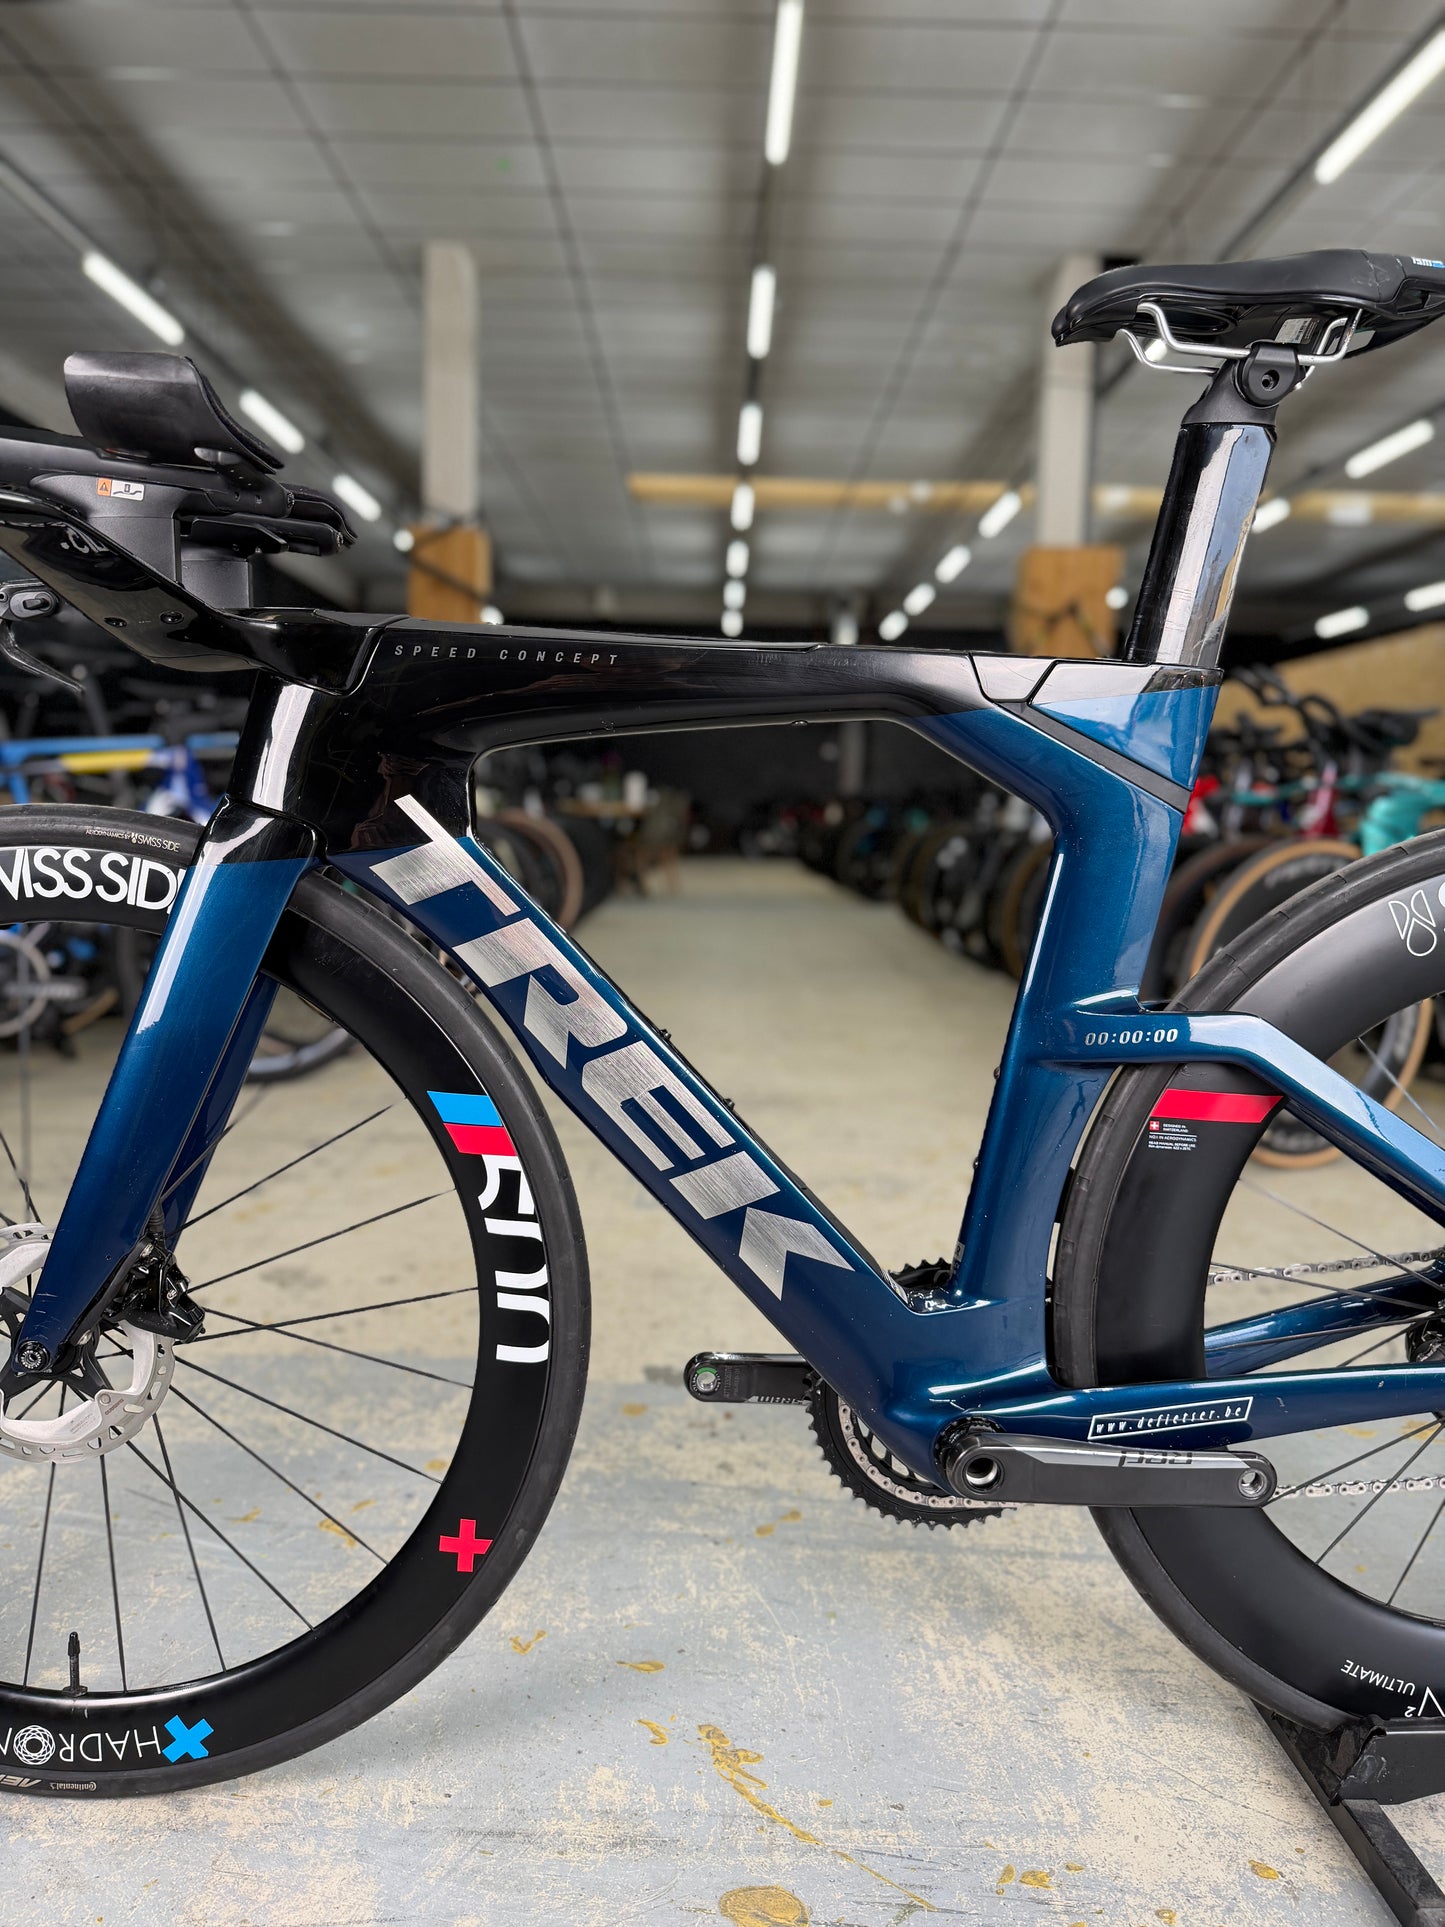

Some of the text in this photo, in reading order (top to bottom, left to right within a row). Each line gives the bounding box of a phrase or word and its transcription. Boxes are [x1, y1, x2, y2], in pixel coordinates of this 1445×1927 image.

[394, 645, 618, 664] SPEED CONCEPT
[138, 834, 162, 848] SWISS
[162, 840, 181, 852] SIDE
[95, 852, 187, 914] SID
[369, 794, 856, 1301] TREK
[1085, 1028, 1178, 1046] 00:00:00
[1096, 1405, 1242, 1433] www.defietser.be
[1340, 1659, 1416, 1696] ULTIMATE
[56, 1781, 97, 1791] Continental
